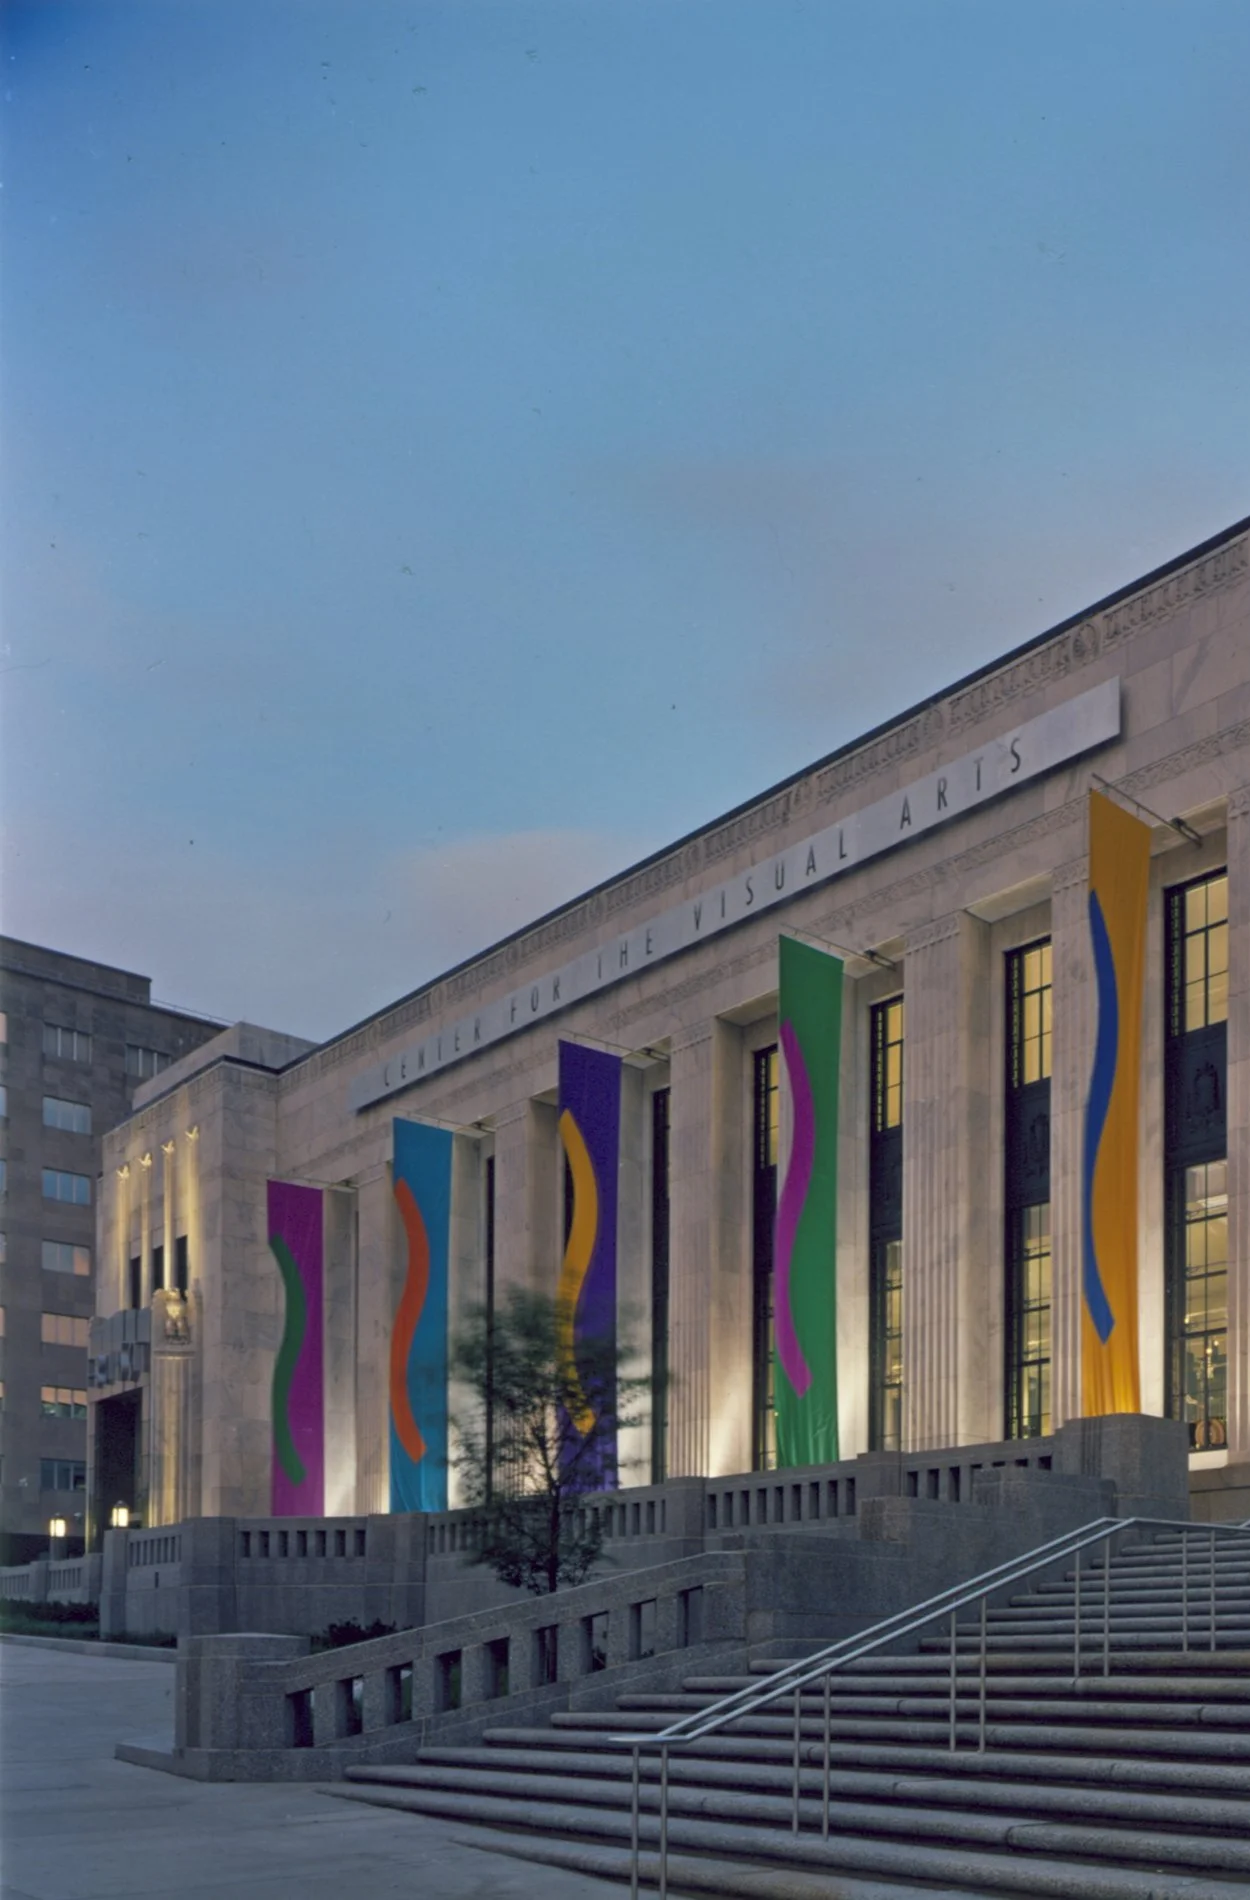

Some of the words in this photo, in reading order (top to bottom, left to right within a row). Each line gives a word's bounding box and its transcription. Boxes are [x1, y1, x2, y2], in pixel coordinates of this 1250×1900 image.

[510, 981, 561, 1023] FOR
[596, 927, 654, 979] THE
[693, 828, 848, 931] VISUAL
[899, 737, 1022, 831] ARTS
